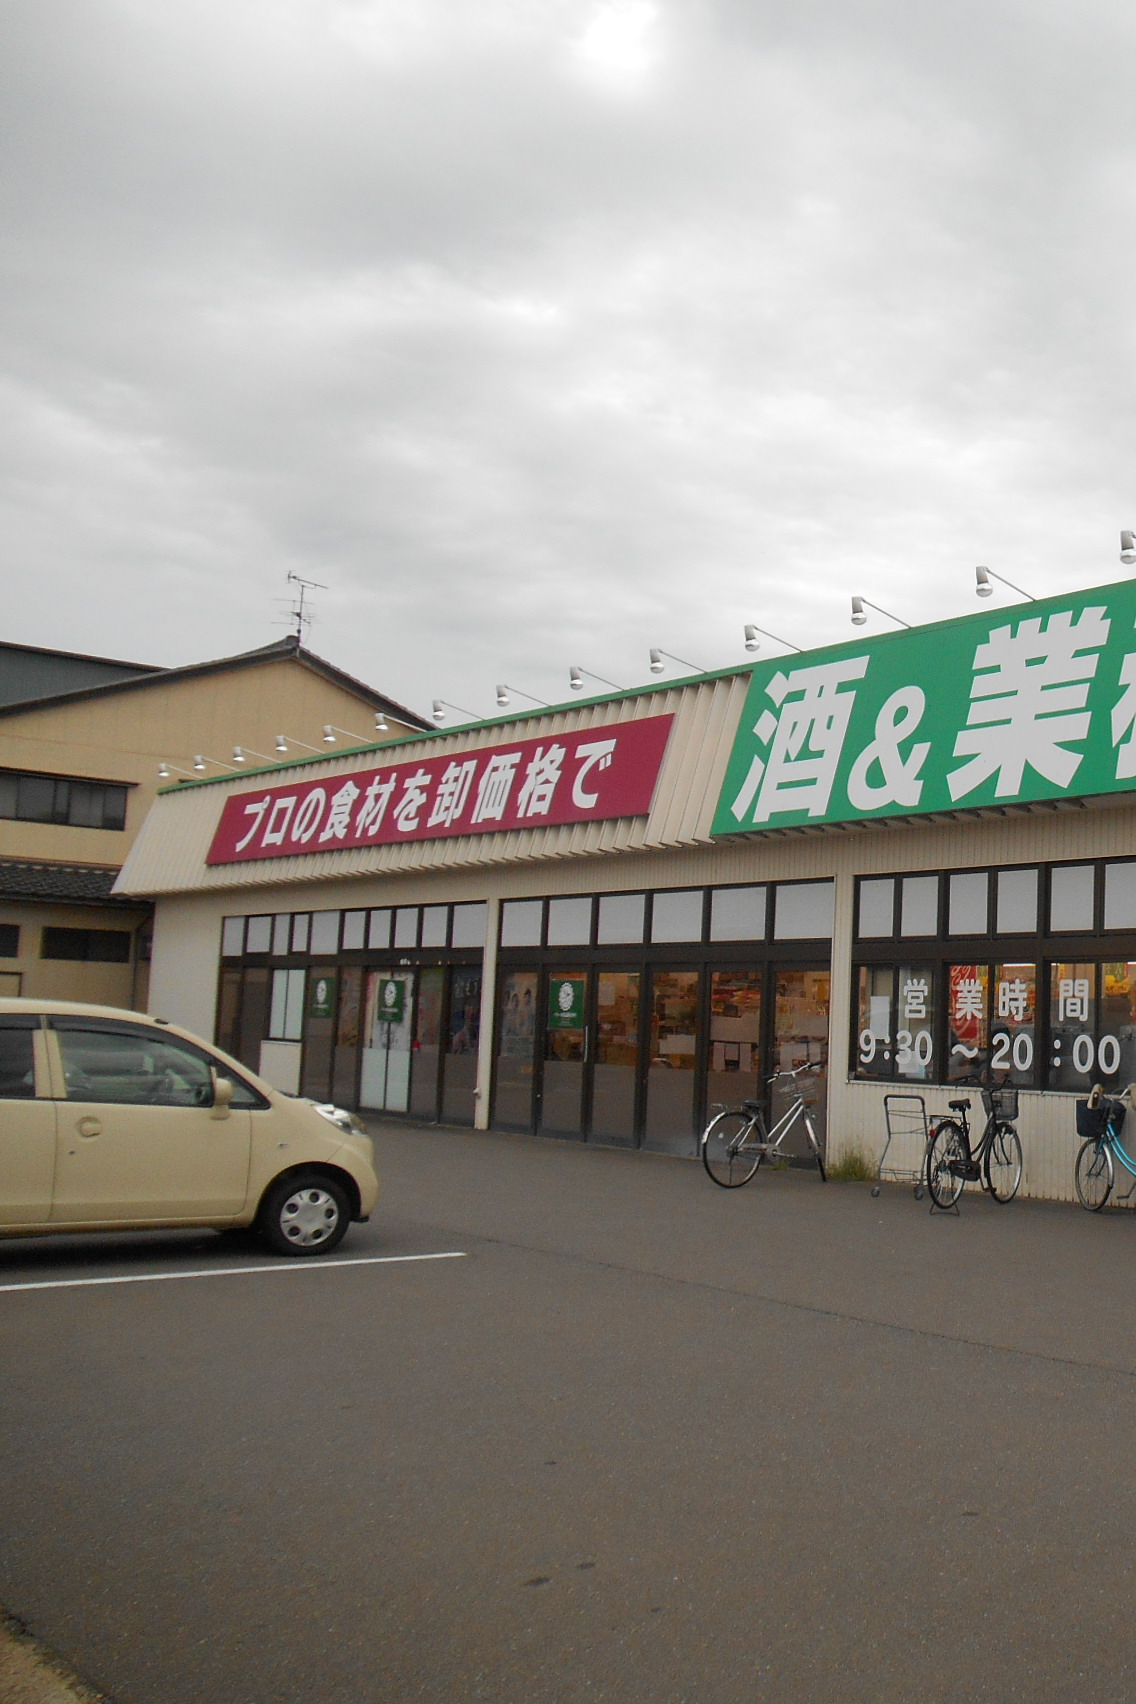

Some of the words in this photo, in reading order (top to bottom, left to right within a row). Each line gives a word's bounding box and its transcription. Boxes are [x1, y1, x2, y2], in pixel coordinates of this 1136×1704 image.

[235, 738, 617, 852] プロの食材を卸価格で
[903, 978, 1089, 1022] 営業時間
